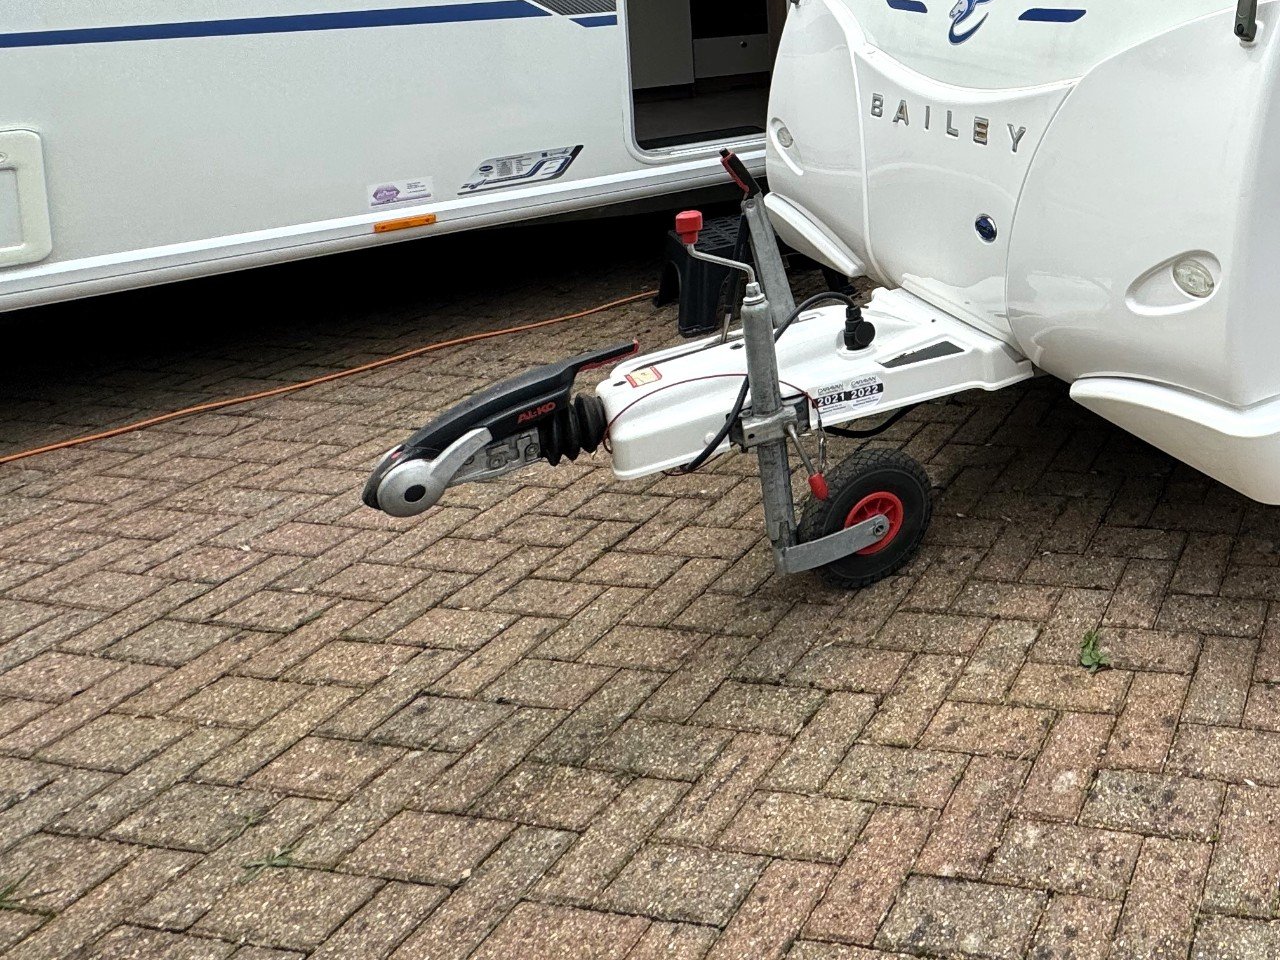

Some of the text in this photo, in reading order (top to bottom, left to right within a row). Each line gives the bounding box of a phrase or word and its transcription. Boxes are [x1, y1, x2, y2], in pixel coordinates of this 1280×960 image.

[870, 93, 1027, 153] BAILEY
[817, 392, 846, 407] 2021
[850, 385, 879, 399] 2022
